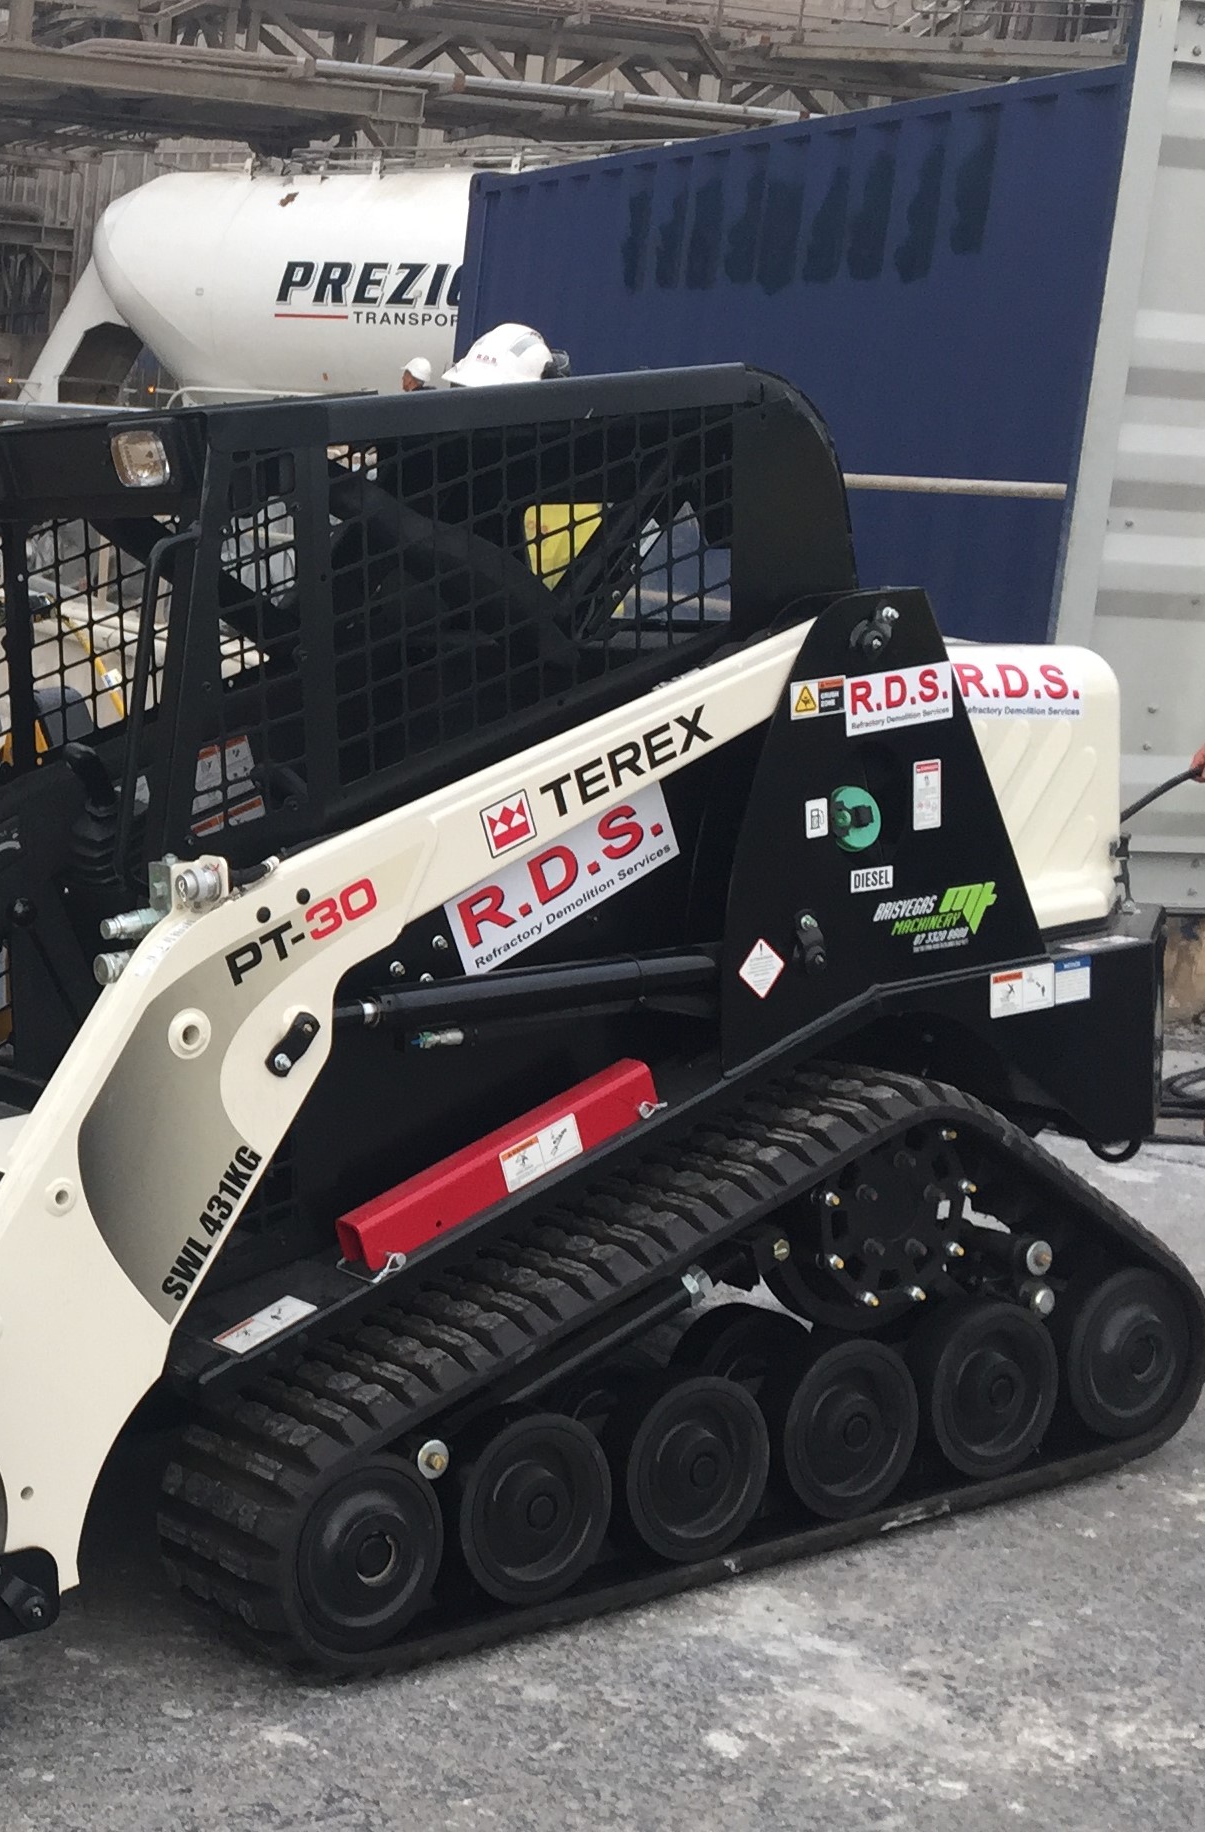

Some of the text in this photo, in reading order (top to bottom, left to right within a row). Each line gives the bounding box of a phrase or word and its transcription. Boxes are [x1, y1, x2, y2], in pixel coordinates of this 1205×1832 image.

[851, 669, 948, 716] R.D.S.
[953, 663, 1080, 700] R.D.S.
[851, 706, 950, 729] Refractory Demolition Services
[966, 705, 1080, 716] efractory Demolition Services
[539, 704, 714, 817] TEREX
[457, 805, 664, 948] R.D.S.
[853, 869, 890, 889] DIESEL
[474, 843, 672, 969] Refractory Demolition Services
[873, 894, 938, 922] BRISVEGAS
[891, 911, 962, 936] MACHINERY
[225, 878, 378, 987] PT-30
[161, 1145, 263, 1301] SWL 431KG
